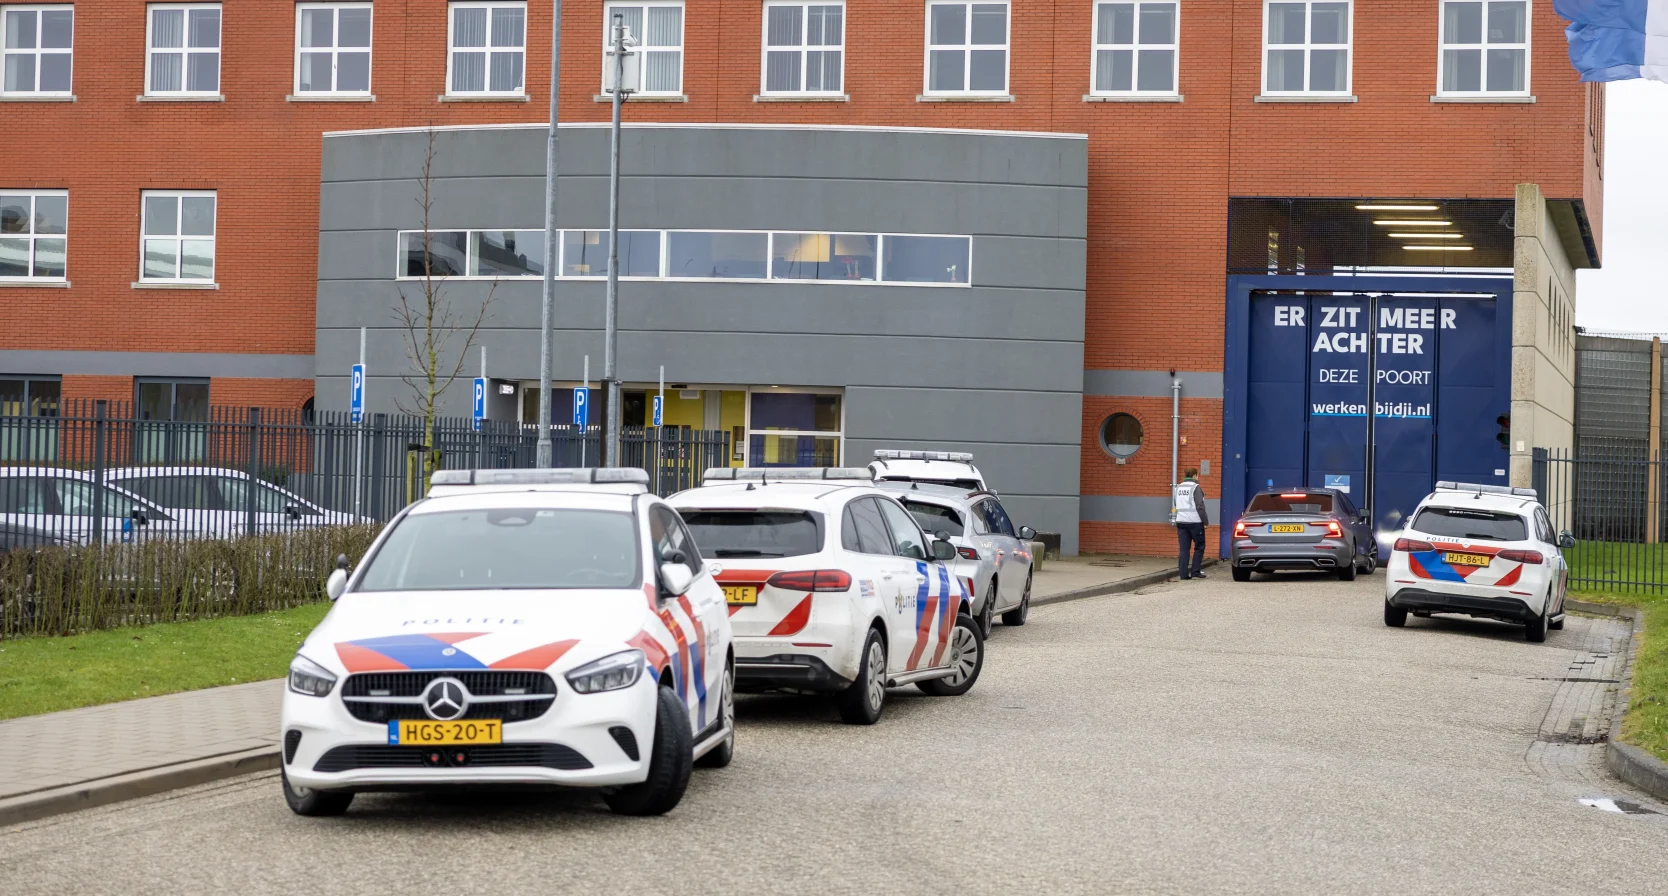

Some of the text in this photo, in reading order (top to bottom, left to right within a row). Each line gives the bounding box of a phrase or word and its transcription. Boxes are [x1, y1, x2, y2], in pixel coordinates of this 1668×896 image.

[1274, 305, 1457, 329] ER ZIT MEER
[353, 371, 361, 402] P
[1319, 368, 1432, 385] DEZE POORT
[475, 383, 483, 412] P
[576, 391, 585, 415] P
[1448, 553, 1485, 565] HJT-86-L
[402, 617, 525, 627] POLITIE
[406, 723, 496, 741] HGS-20-T
